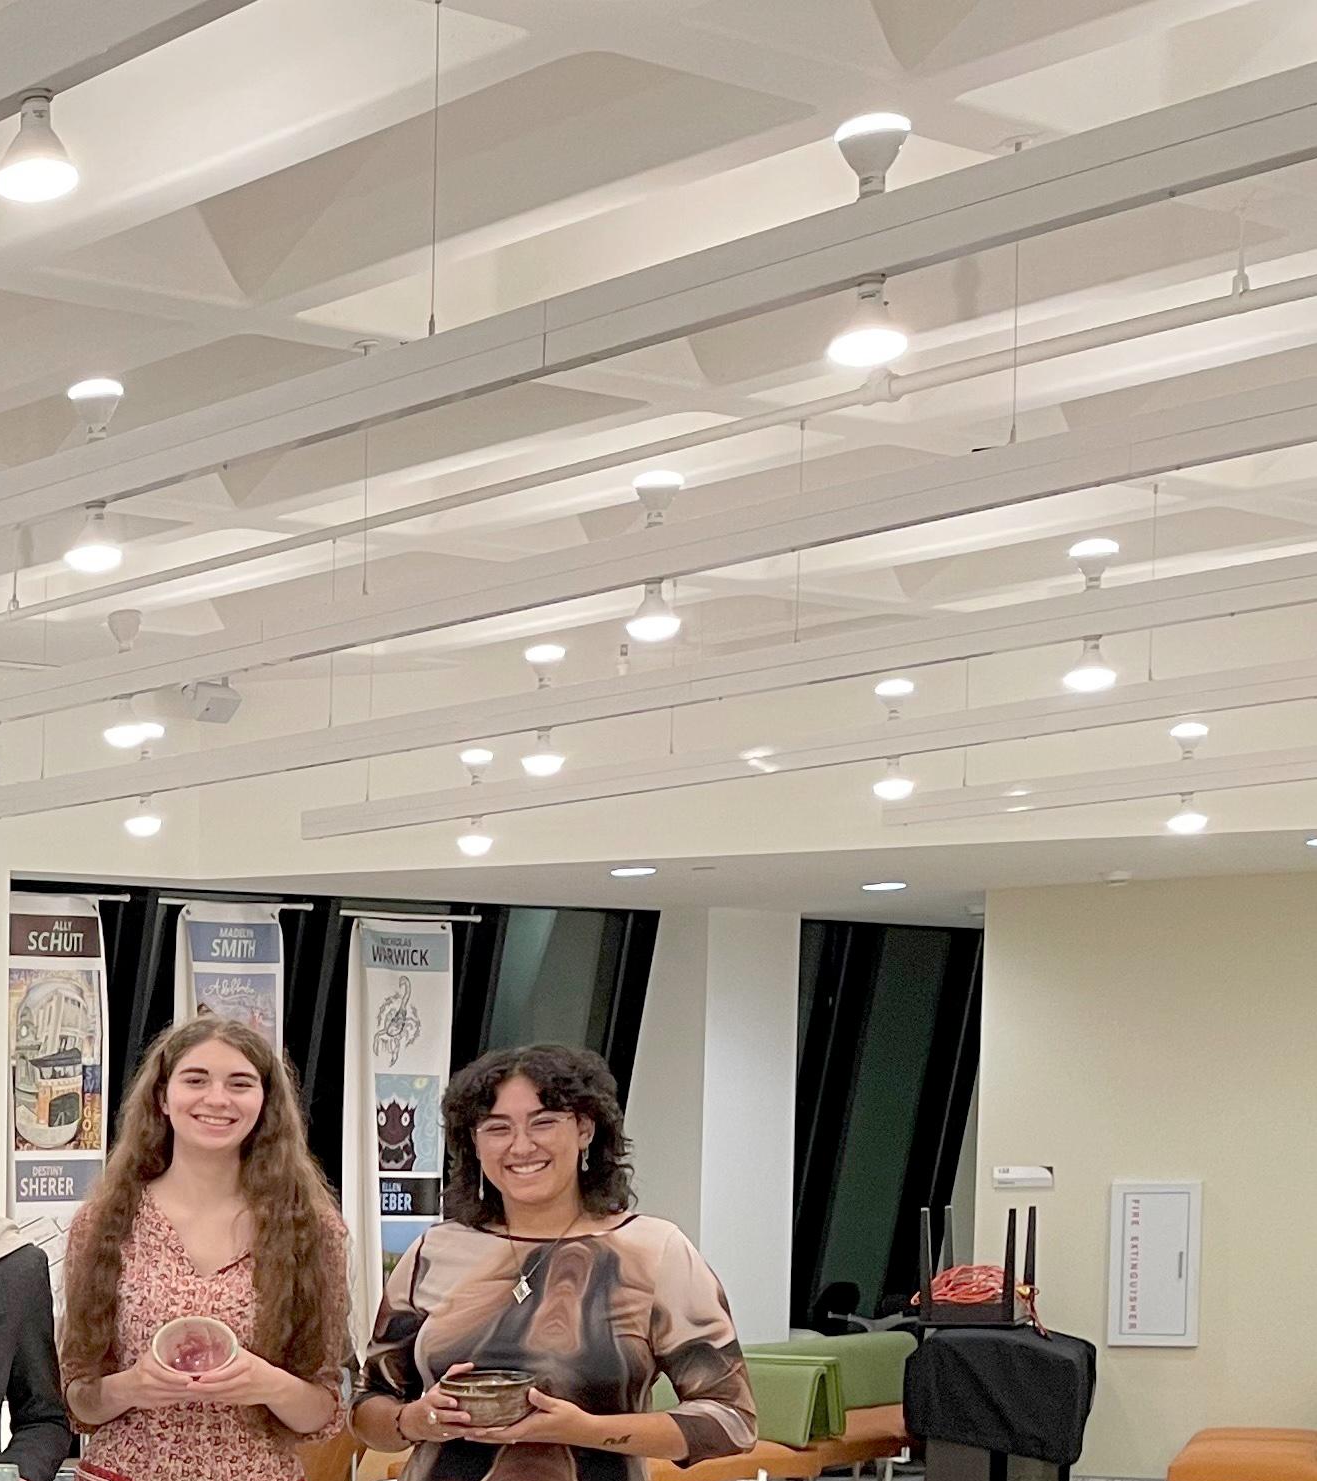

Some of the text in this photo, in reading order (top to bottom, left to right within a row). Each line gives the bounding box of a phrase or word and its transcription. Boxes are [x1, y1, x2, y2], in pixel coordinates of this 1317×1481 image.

[52, 920, 72, 931] ALLY
[28, 931, 84, 952] SCHUTT
[210, 939, 256, 958] SMITH
[372, 945, 429, 966] WARWICK
[32, 1166, 64, 1177] DESTINY
[20, 1177, 74, 1197] SHERER
[380, 1193, 412, 1211] EBER
[1128, 1199, 1140, 1330] FIRE EXTINGUISHER
